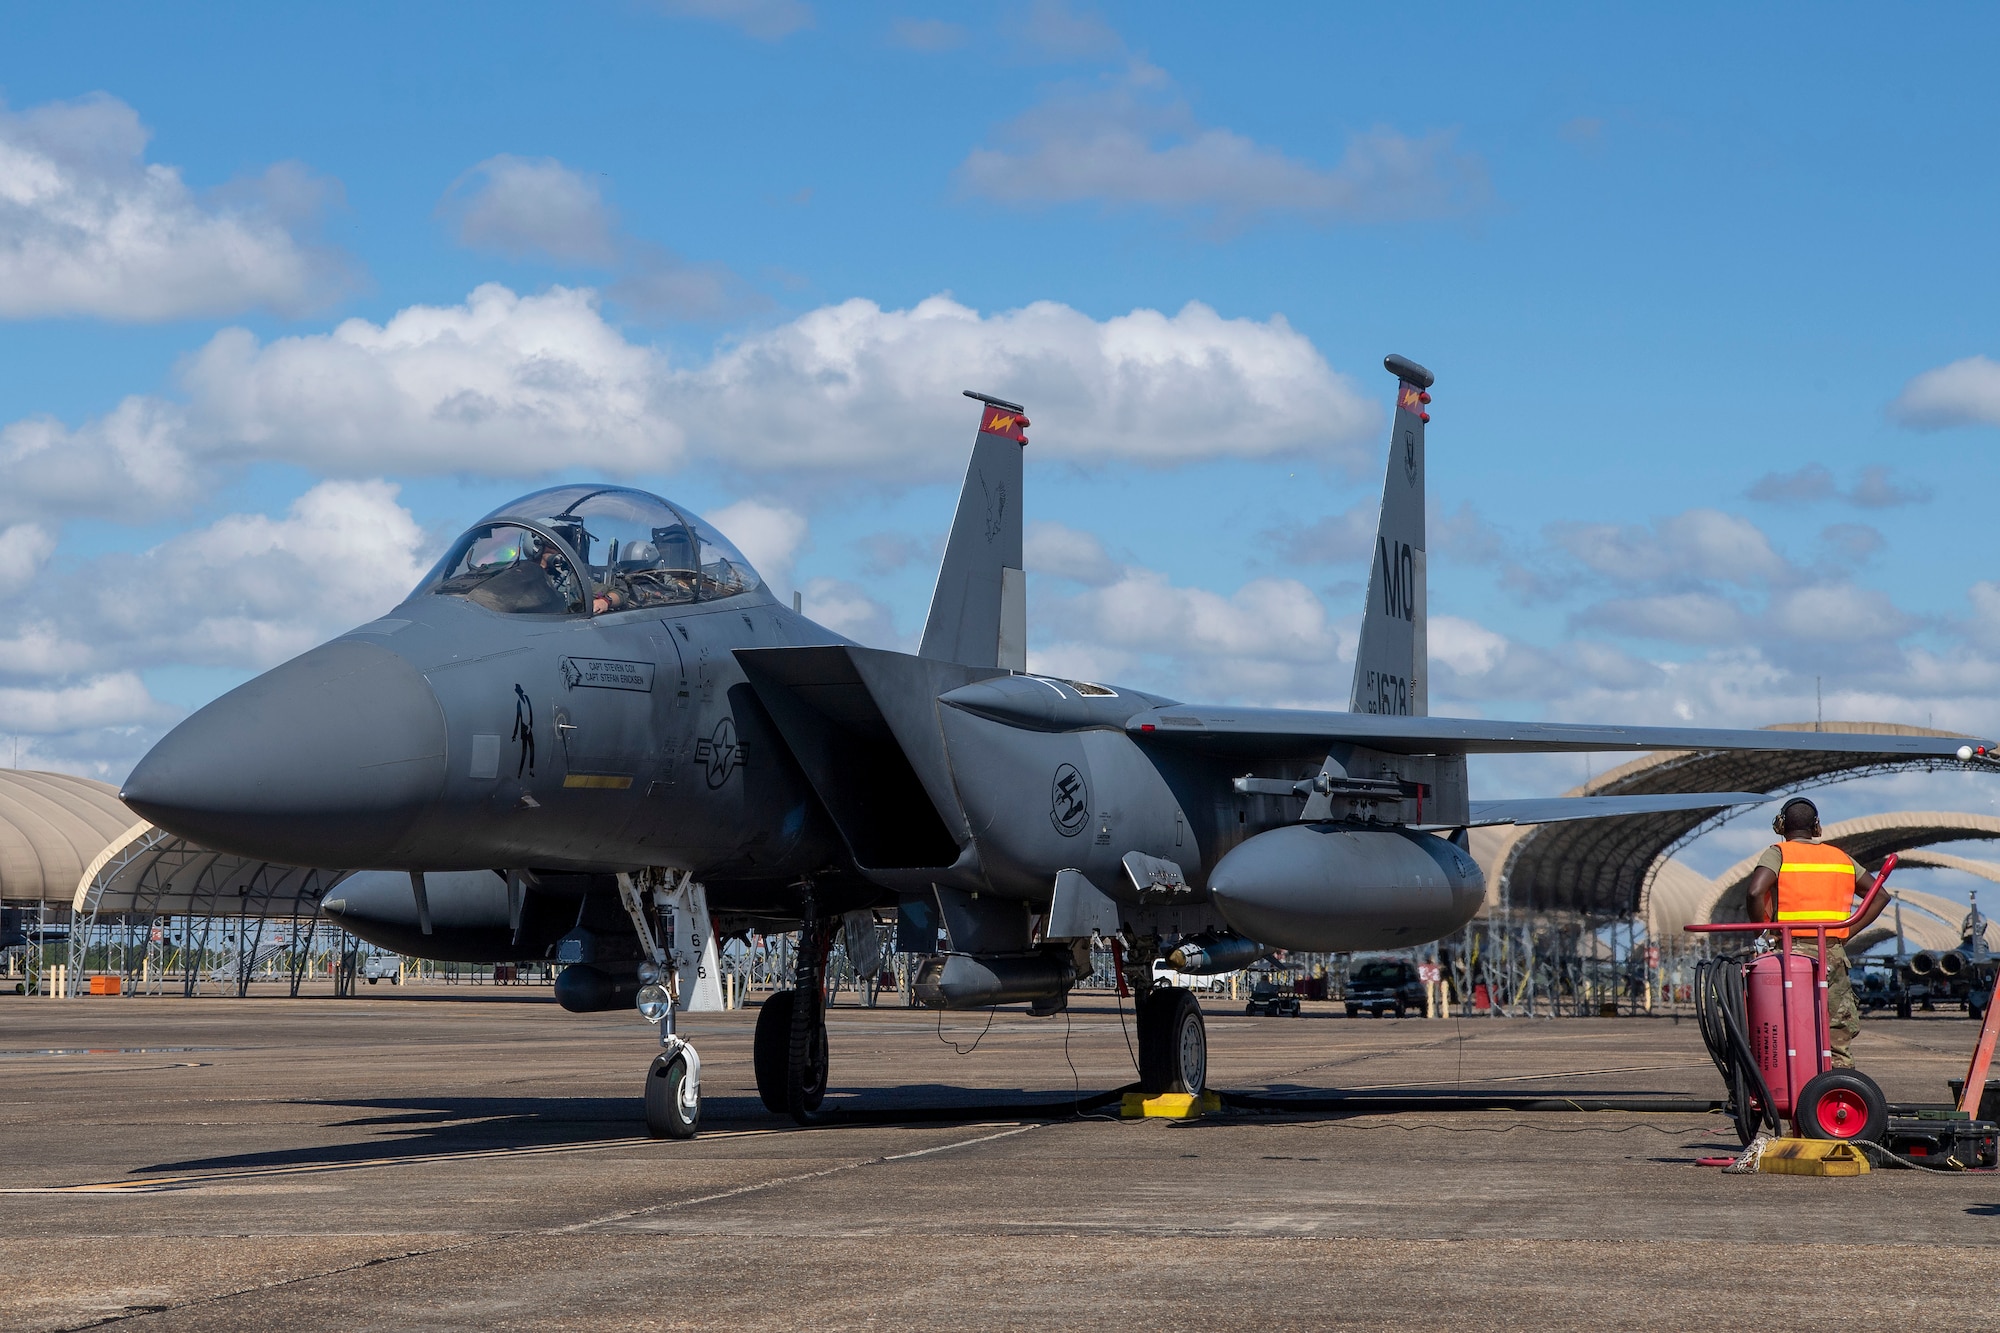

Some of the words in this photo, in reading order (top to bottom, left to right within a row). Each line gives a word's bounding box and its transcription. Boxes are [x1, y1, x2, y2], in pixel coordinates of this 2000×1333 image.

[1380, 536, 1414, 622] MO
[585, 672, 599, 681] CAPT
[588, 662, 603, 671] CAPT
[604, 663, 625, 672] STEVEN
[625, 664, 636, 673] COX
[1366, 670, 1375, 691] AF
[1377, 672, 1407, 716] 1678
